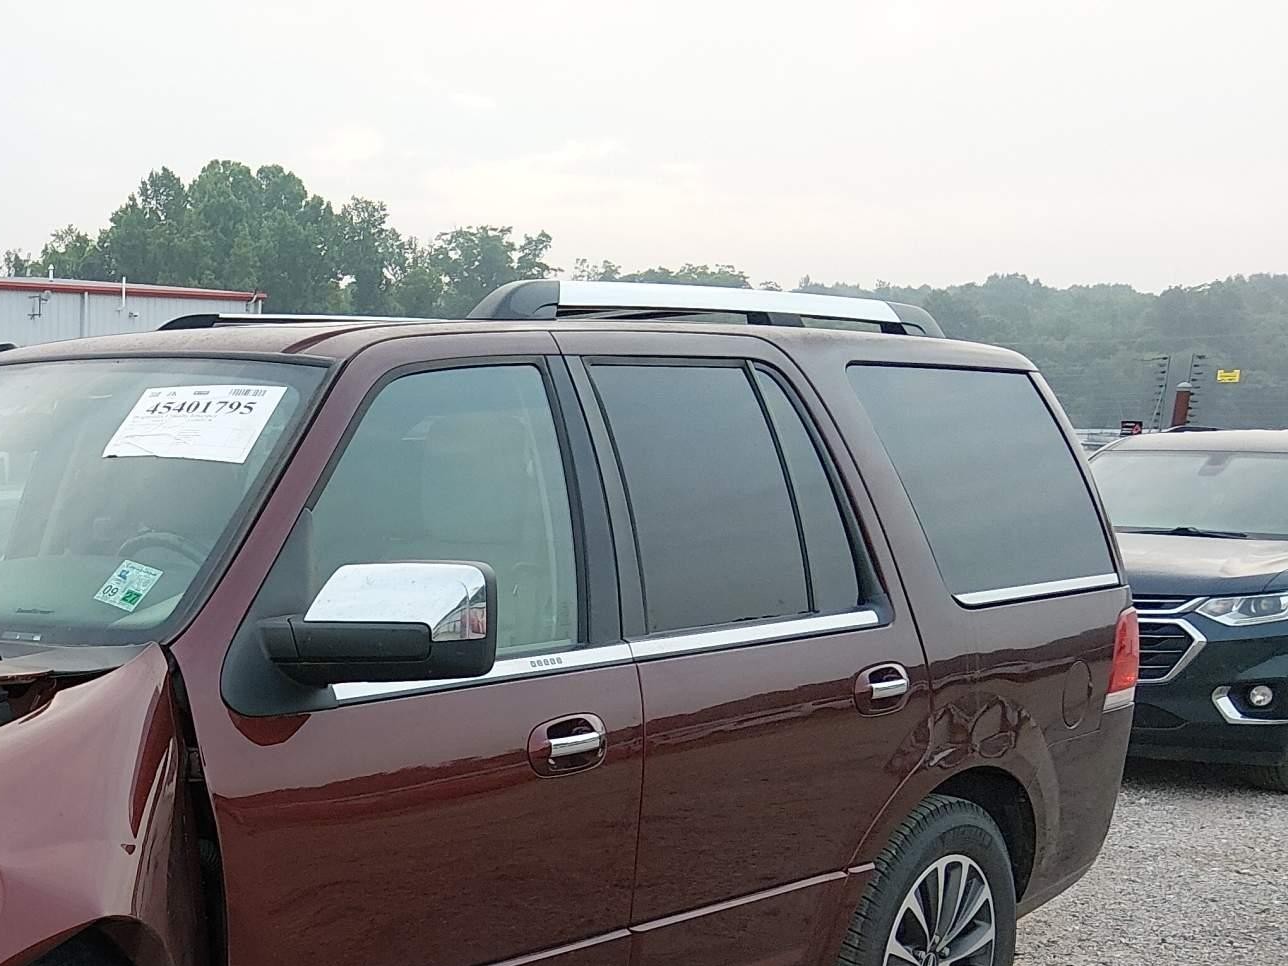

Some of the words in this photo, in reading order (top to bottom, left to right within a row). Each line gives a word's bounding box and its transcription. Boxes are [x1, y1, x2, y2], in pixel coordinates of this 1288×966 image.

[146, 401, 257, 415] 45401795
[102, 584, 119, 597] 09
[122, 590, 142, 605] 27
